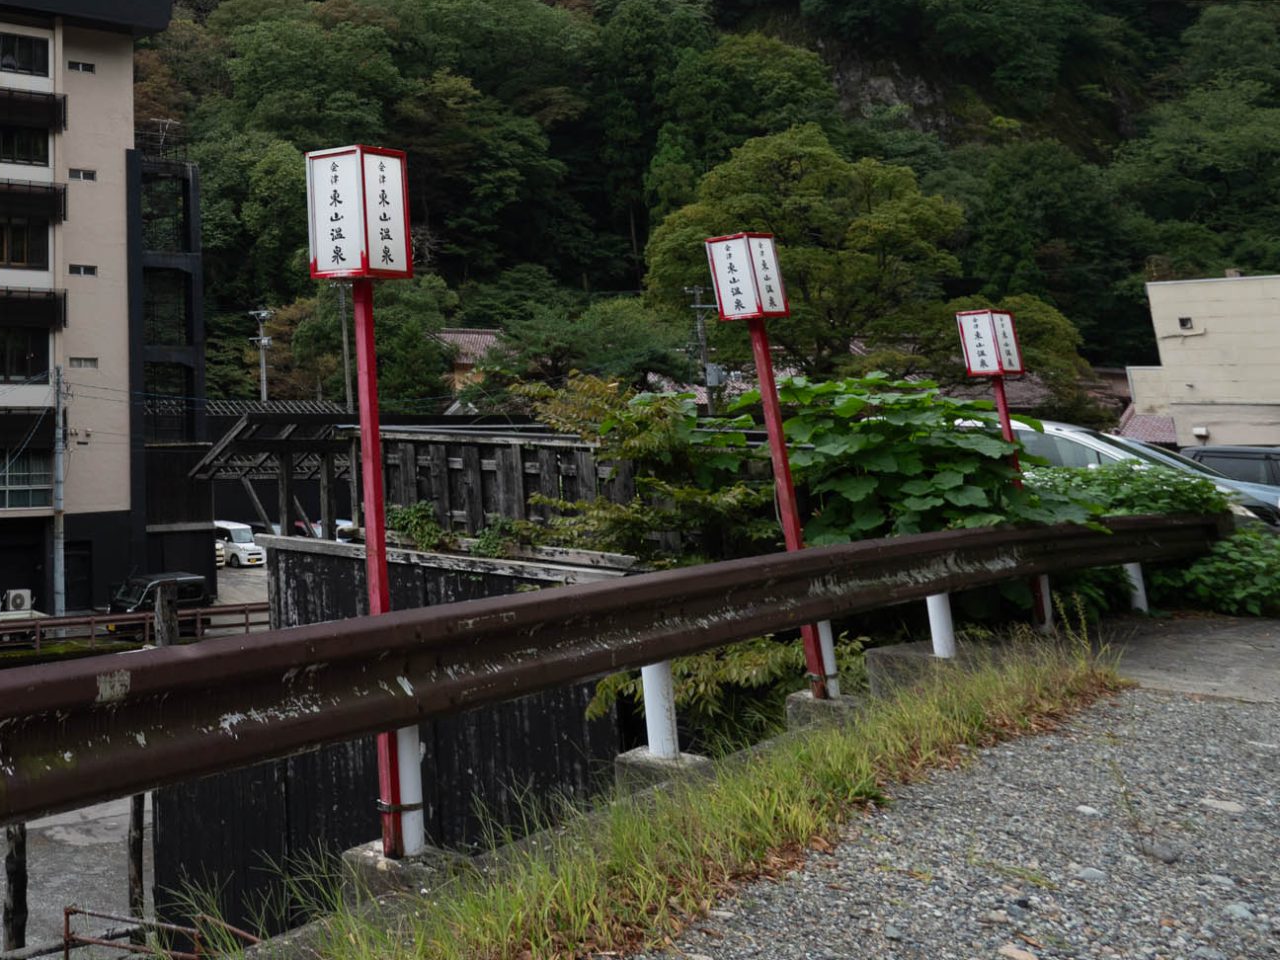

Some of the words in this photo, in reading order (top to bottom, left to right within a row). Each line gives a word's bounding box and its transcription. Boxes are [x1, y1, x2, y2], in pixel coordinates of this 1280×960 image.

[329, 161, 347, 265] 会津東山温泉
[377, 161, 395, 265] 会津東山温泉
